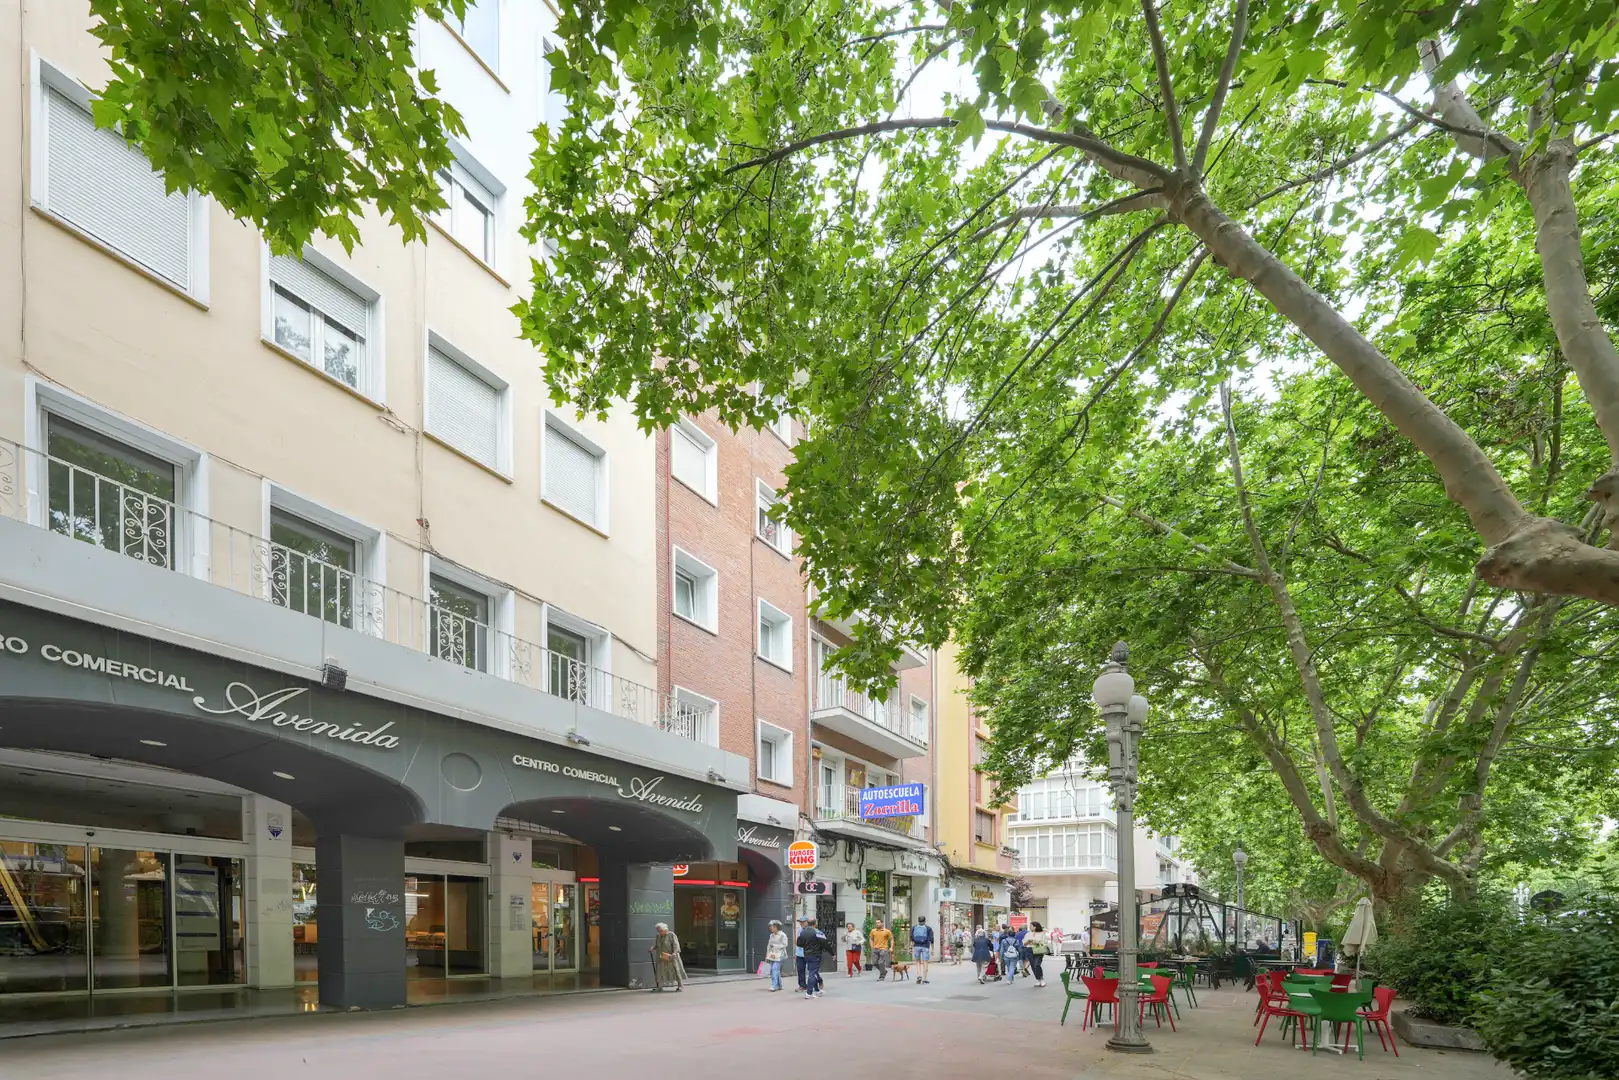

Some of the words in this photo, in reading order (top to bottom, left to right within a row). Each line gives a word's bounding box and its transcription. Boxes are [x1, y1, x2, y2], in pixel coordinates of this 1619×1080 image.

[0, 633, 29, 654] O
[40, 643, 194, 692] COMERCIAL
[193, 681, 400, 750] Avenida
[512, 754, 560, 774] CENTRO
[562, 765, 620, 787] COMERCIAL
[617, 775, 703, 813] Avenida
[862, 786, 920, 801] AUTOESCUELA
[864, 800, 919, 817] Zorrilla
[736, 826, 781, 849] Avenida
[789, 856, 815, 865] KING
